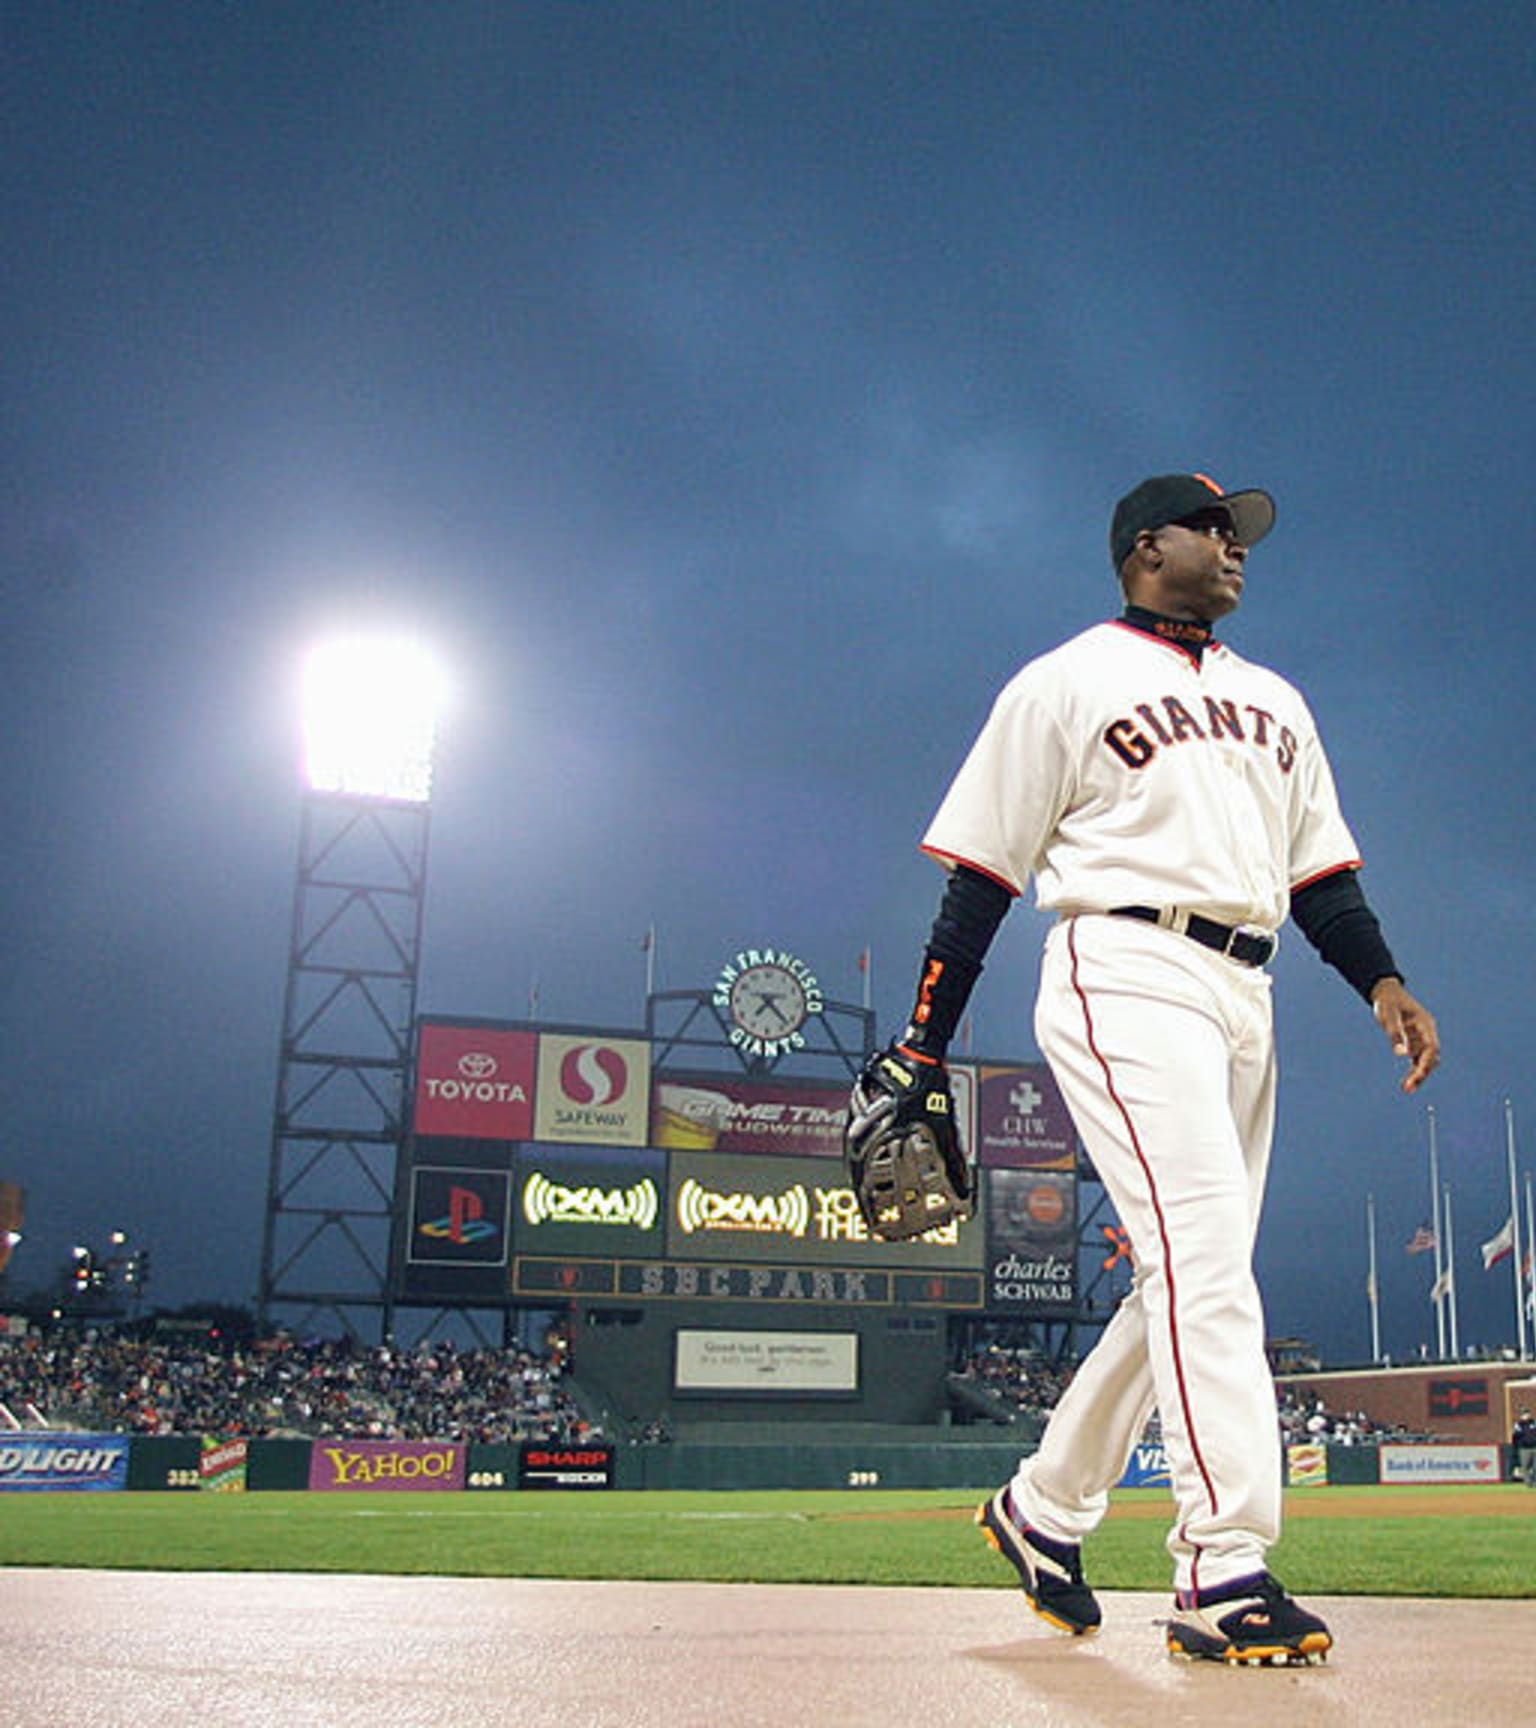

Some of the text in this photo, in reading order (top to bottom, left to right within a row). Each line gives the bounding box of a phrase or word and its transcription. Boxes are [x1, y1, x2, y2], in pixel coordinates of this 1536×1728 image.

[1104, 695, 1298, 774] GIANTS
[713, 948, 823, 1013] SAN FRANCISCO
[730, 1028, 805, 1057] GIANTS
[426, 1079, 527, 1103] TOYOTA
[555, 1109, 628, 1127] SAFEWAY
[1003, 1116, 1048, 1135] CHW
[814, 1187, 859, 1216] YO
[994, 1253, 1071, 1283] charles
[641, 1265, 866, 1300] SBC PARK
[993, 1282, 1072, 1301] SCHWAB
[23, 1449, 124, 1472] LIGHT
[325, 1448, 455, 1484] YAHOO!
[526, 1452, 608, 1466] SHARP
[1136, 1449, 1169, 1471] VIS
[1387, 1457, 1413, 1472] Bank
[1428, 1458, 1472, 1472] America
